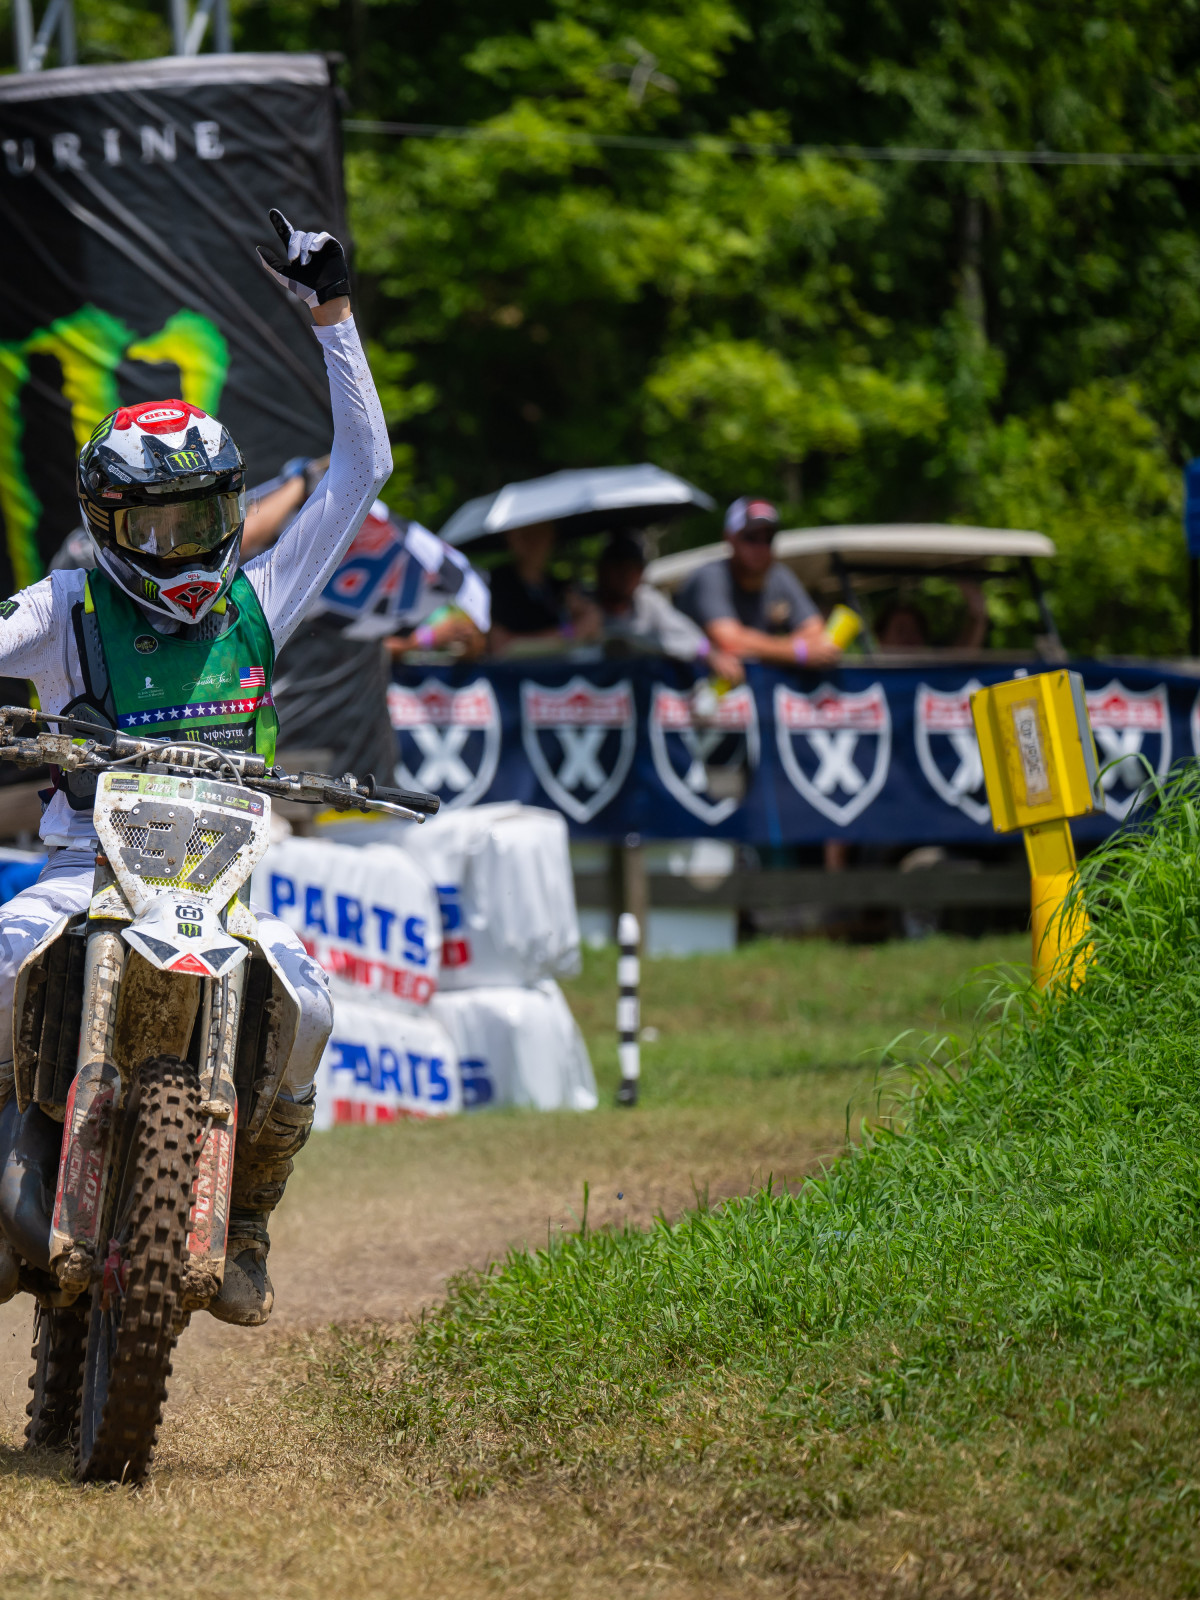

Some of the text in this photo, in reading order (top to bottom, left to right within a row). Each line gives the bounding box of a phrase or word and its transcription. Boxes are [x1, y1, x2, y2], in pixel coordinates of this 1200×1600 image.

[145, 410, 177, 421] BELL
[119, 801, 253, 886] 37
[270, 872, 429, 967] PARTS
